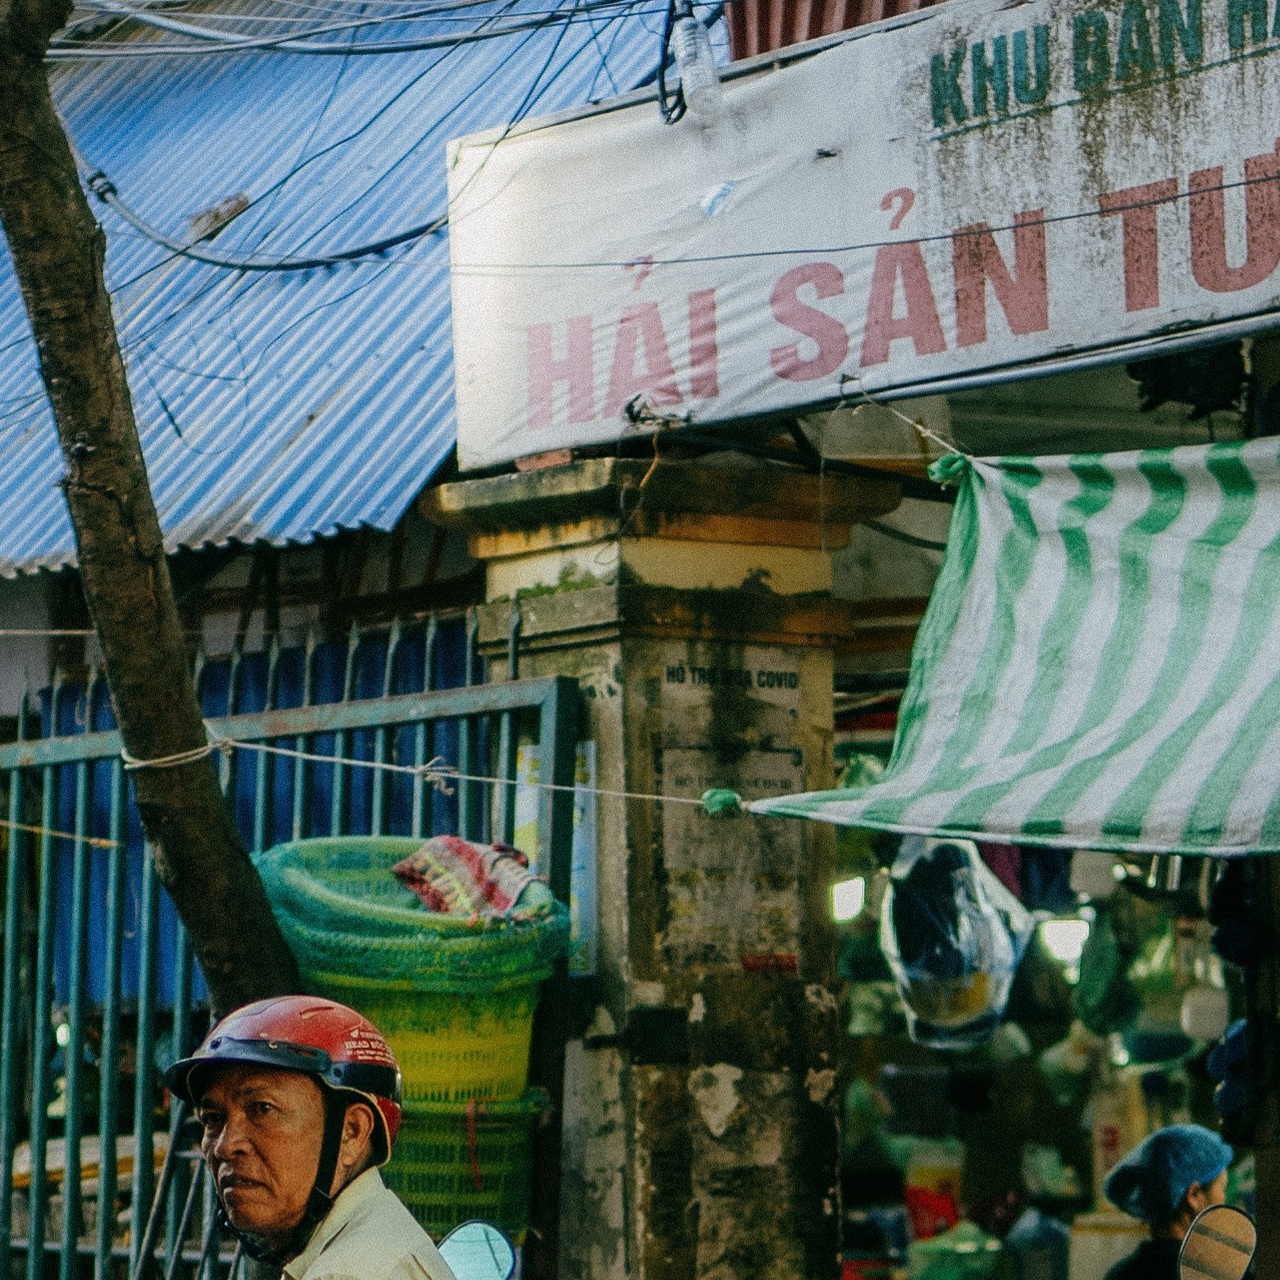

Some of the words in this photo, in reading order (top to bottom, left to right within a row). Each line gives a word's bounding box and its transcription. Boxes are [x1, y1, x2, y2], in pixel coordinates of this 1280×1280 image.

[930, 23, 1049, 129] KHU
[527, 256, 721, 429] HẢI
[768, 187, 1049, 384] SẢN
